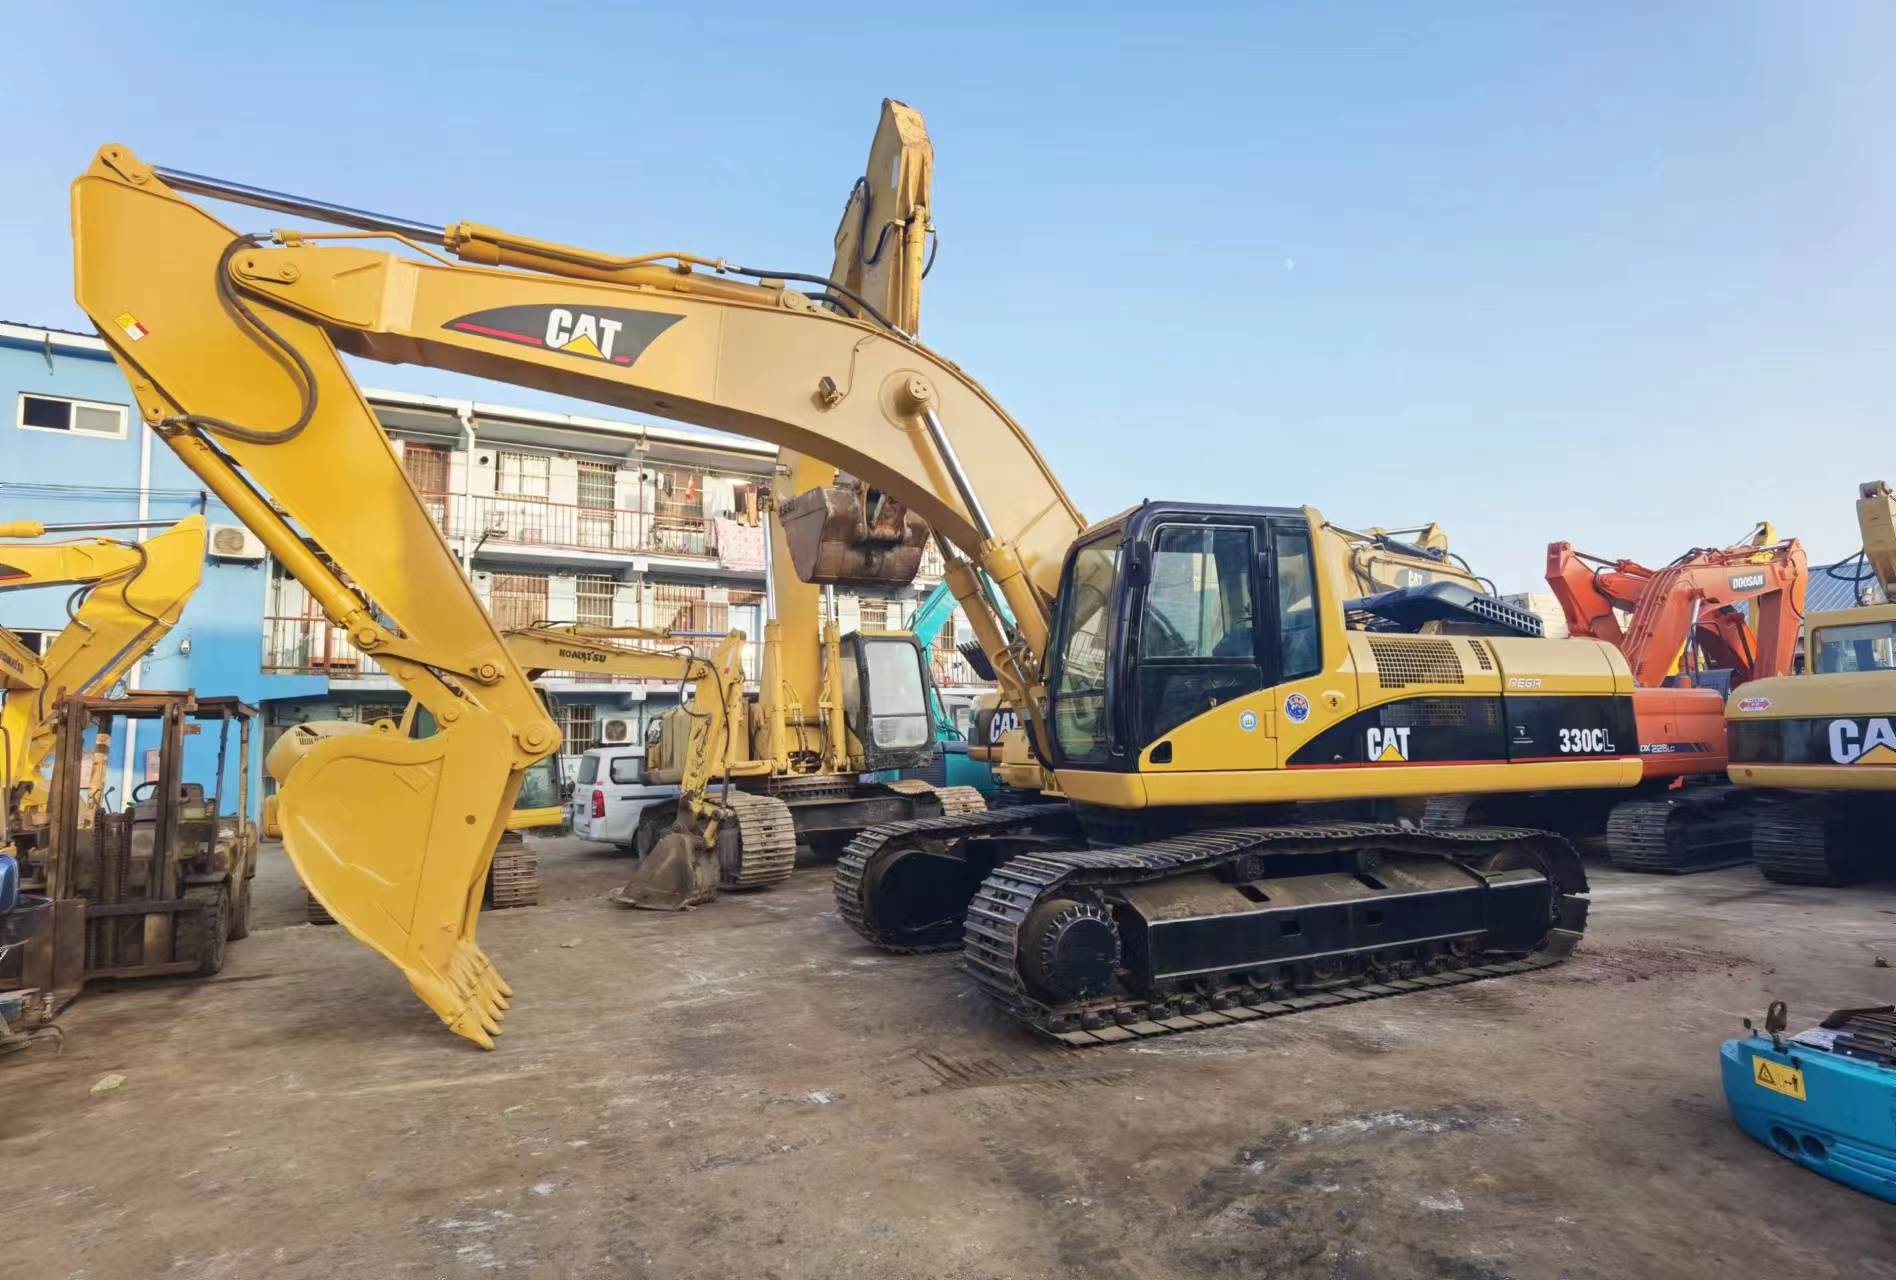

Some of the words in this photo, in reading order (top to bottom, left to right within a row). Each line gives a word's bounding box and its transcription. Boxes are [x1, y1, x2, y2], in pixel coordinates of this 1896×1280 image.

[545, 308, 623, 360] CAT
[1732, 575, 1763, 590] DOOSAN
[559, 648, 607, 663] KOMATSU
[1367, 727, 1411, 762] CAT
[1559, 728, 1615, 753] 330CL
